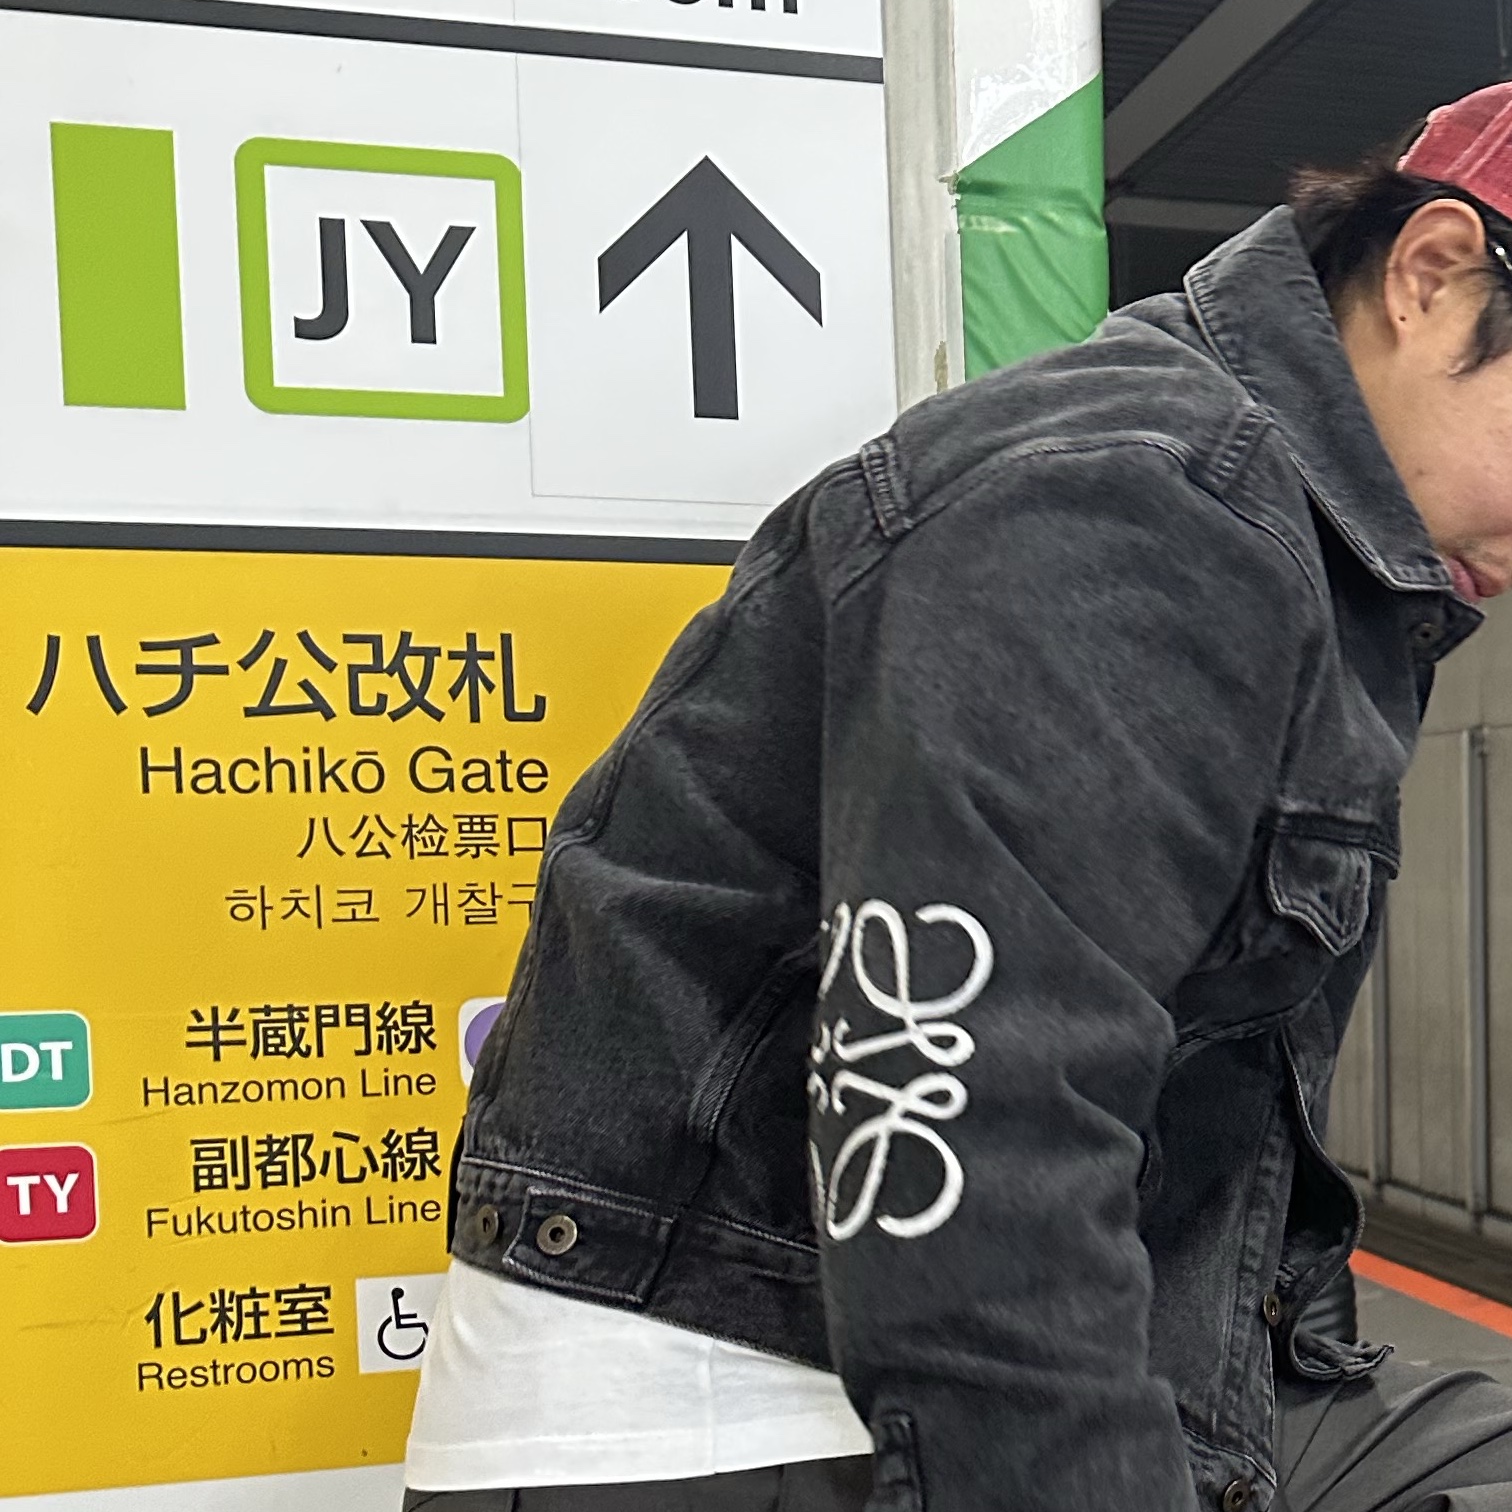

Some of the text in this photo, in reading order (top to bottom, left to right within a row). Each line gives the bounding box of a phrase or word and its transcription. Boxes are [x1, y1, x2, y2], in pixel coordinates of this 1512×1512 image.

[293, 217, 477, 345] JY
[26, 629, 547, 724] ハチ公改札
[140, 745, 549, 795] Hachikō Gate
[296, 812, 548, 861] 八公检票口
[224, 884, 380, 931] 하치코
[185, 999, 437, 1063] 半蔵門線
[1, 1041, 73, 1083] DT
[142, 1067, 437, 1107] Hanzomon Line
[189, 1126, 442, 1194] 副都心線
[6, 1172, 80, 1216] TY
[146, 1194, 442, 1239] Fukutoshin Line
[144, 1283, 335, 1349] 化粧室
[137, 1355, 335, 1392] Restrooms
